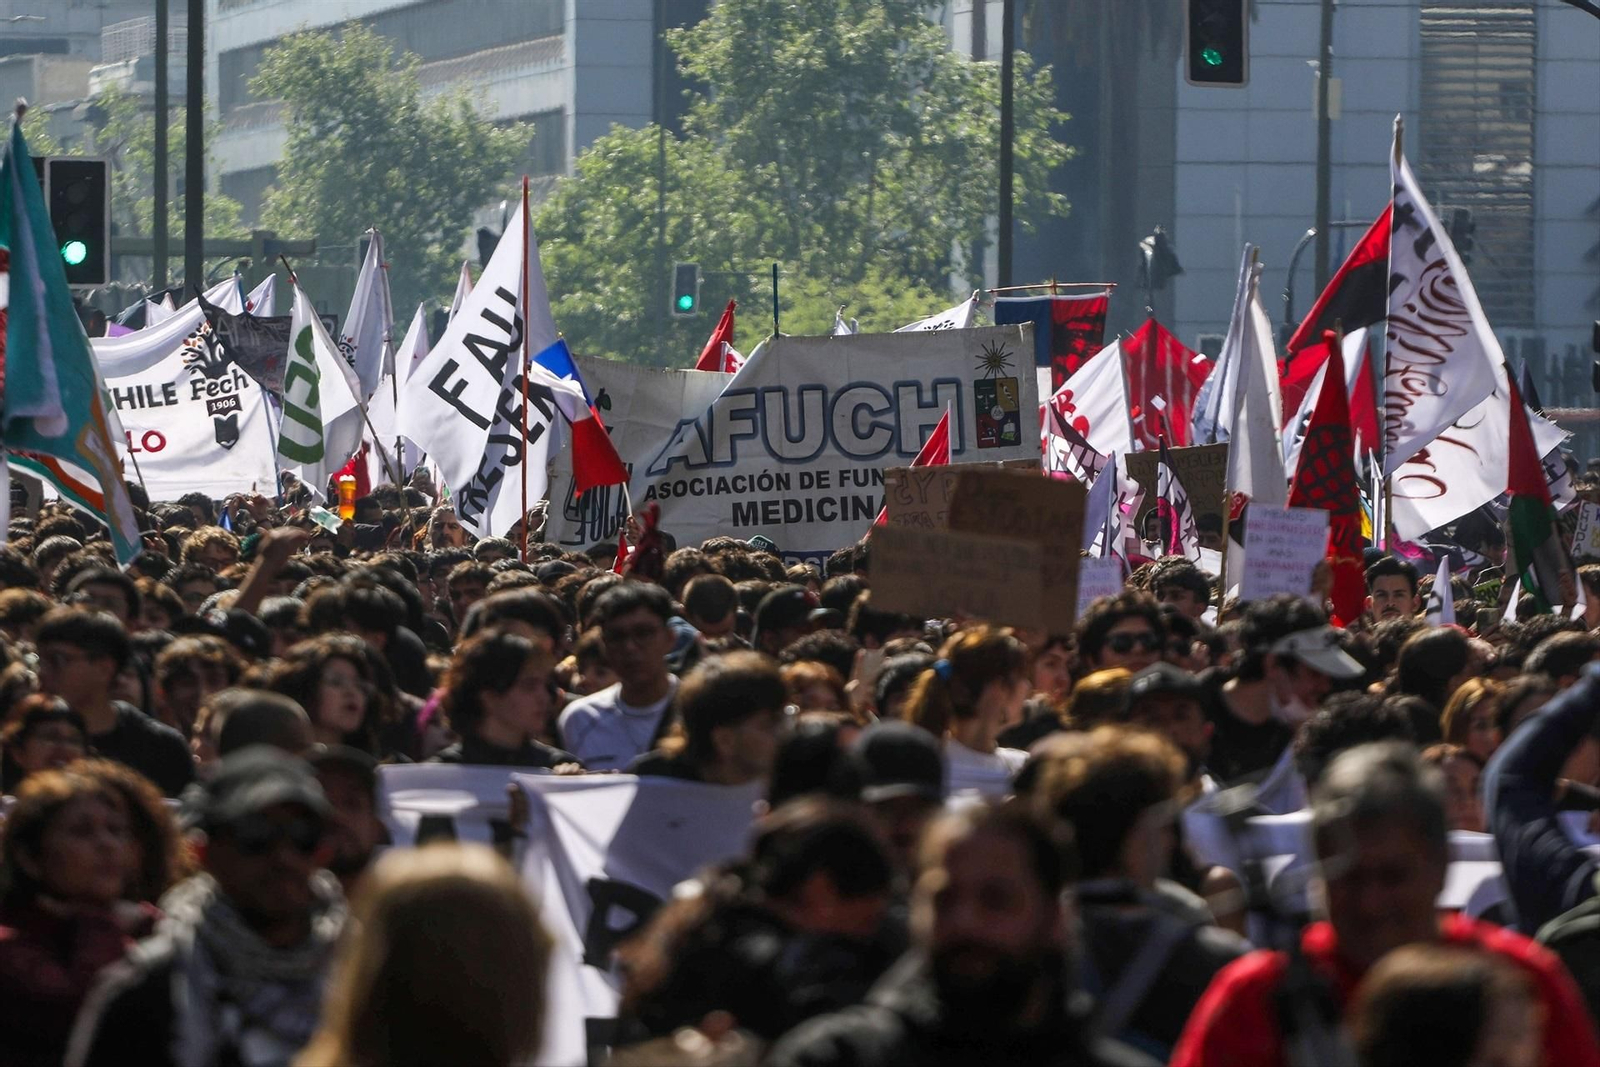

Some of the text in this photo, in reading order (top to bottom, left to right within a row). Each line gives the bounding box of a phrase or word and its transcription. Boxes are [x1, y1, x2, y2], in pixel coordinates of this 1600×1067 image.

[428, 286, 523, 430] FAU
[109, 381, 179, 410] HILE
[190, 368, 249, 400] Fech
[211, 397, 236, 411] 1906
[645, 377, 965, 477] AFUCH
[644, 469, 791, 502] ASOCIACIÓN
[800, 471, 830, 490] DE
